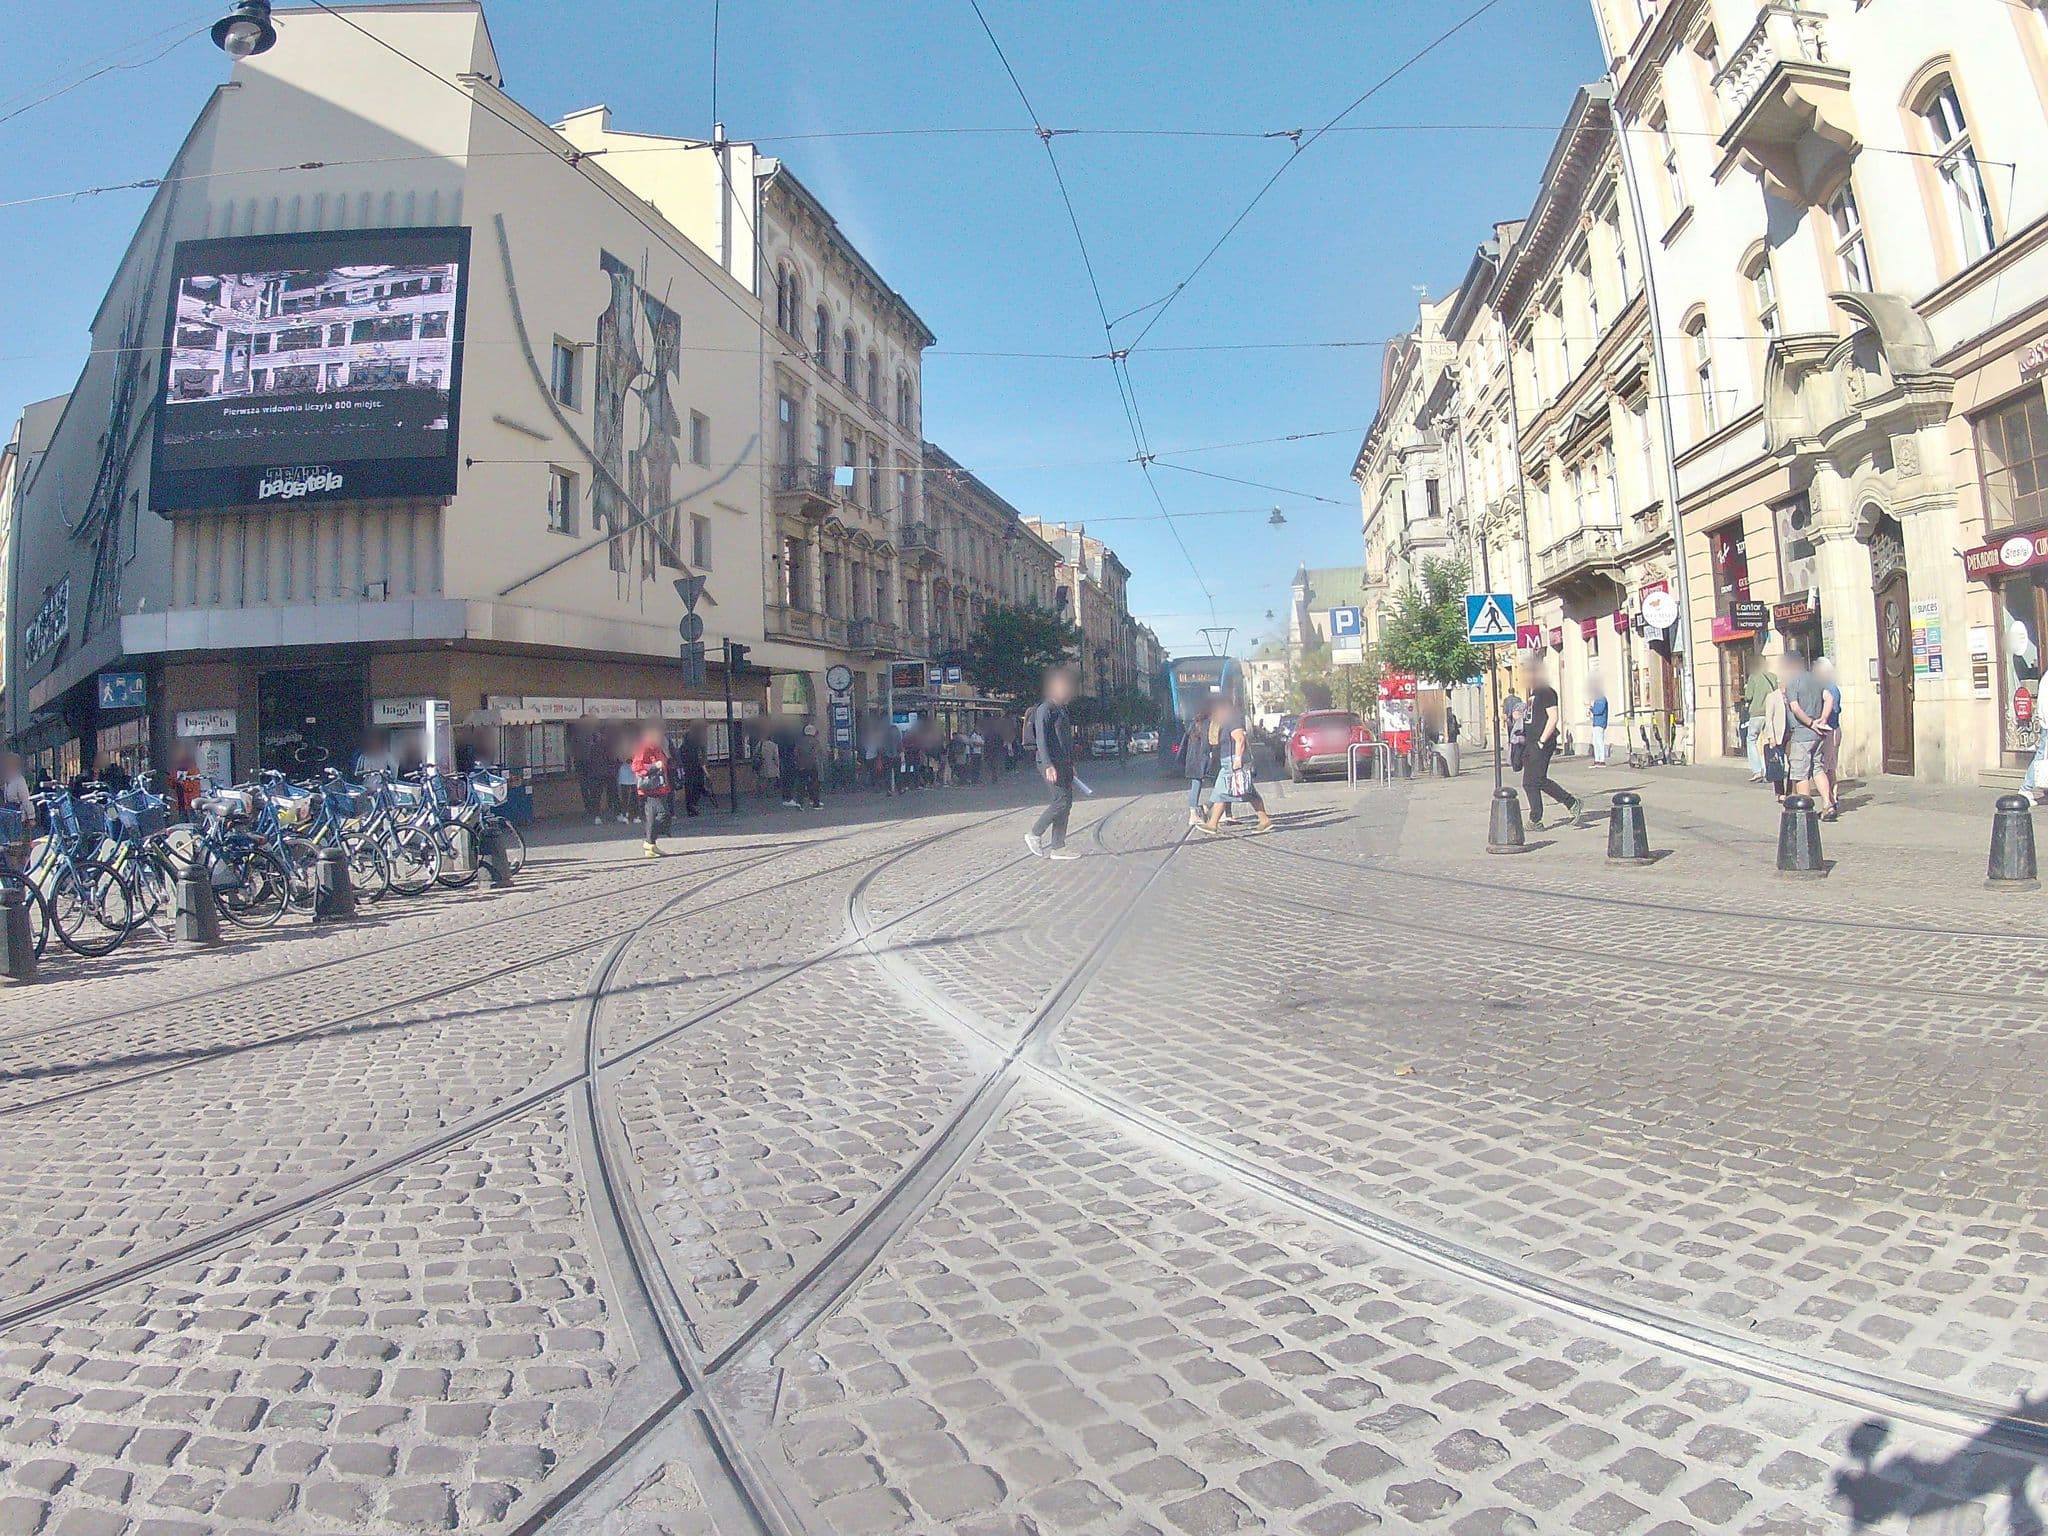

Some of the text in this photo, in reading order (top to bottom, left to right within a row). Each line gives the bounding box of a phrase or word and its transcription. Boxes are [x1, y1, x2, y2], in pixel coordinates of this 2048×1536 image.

[223, 406, 260, 416] Pierwsza
[262, 403, 303, 413] widownia
[259, 472, 343, 500] bagatela
[1736, 603, 1762, 611] Kantor
[1335, 609, 1354, 634] P
[1525, 633, 1541, 649] M
